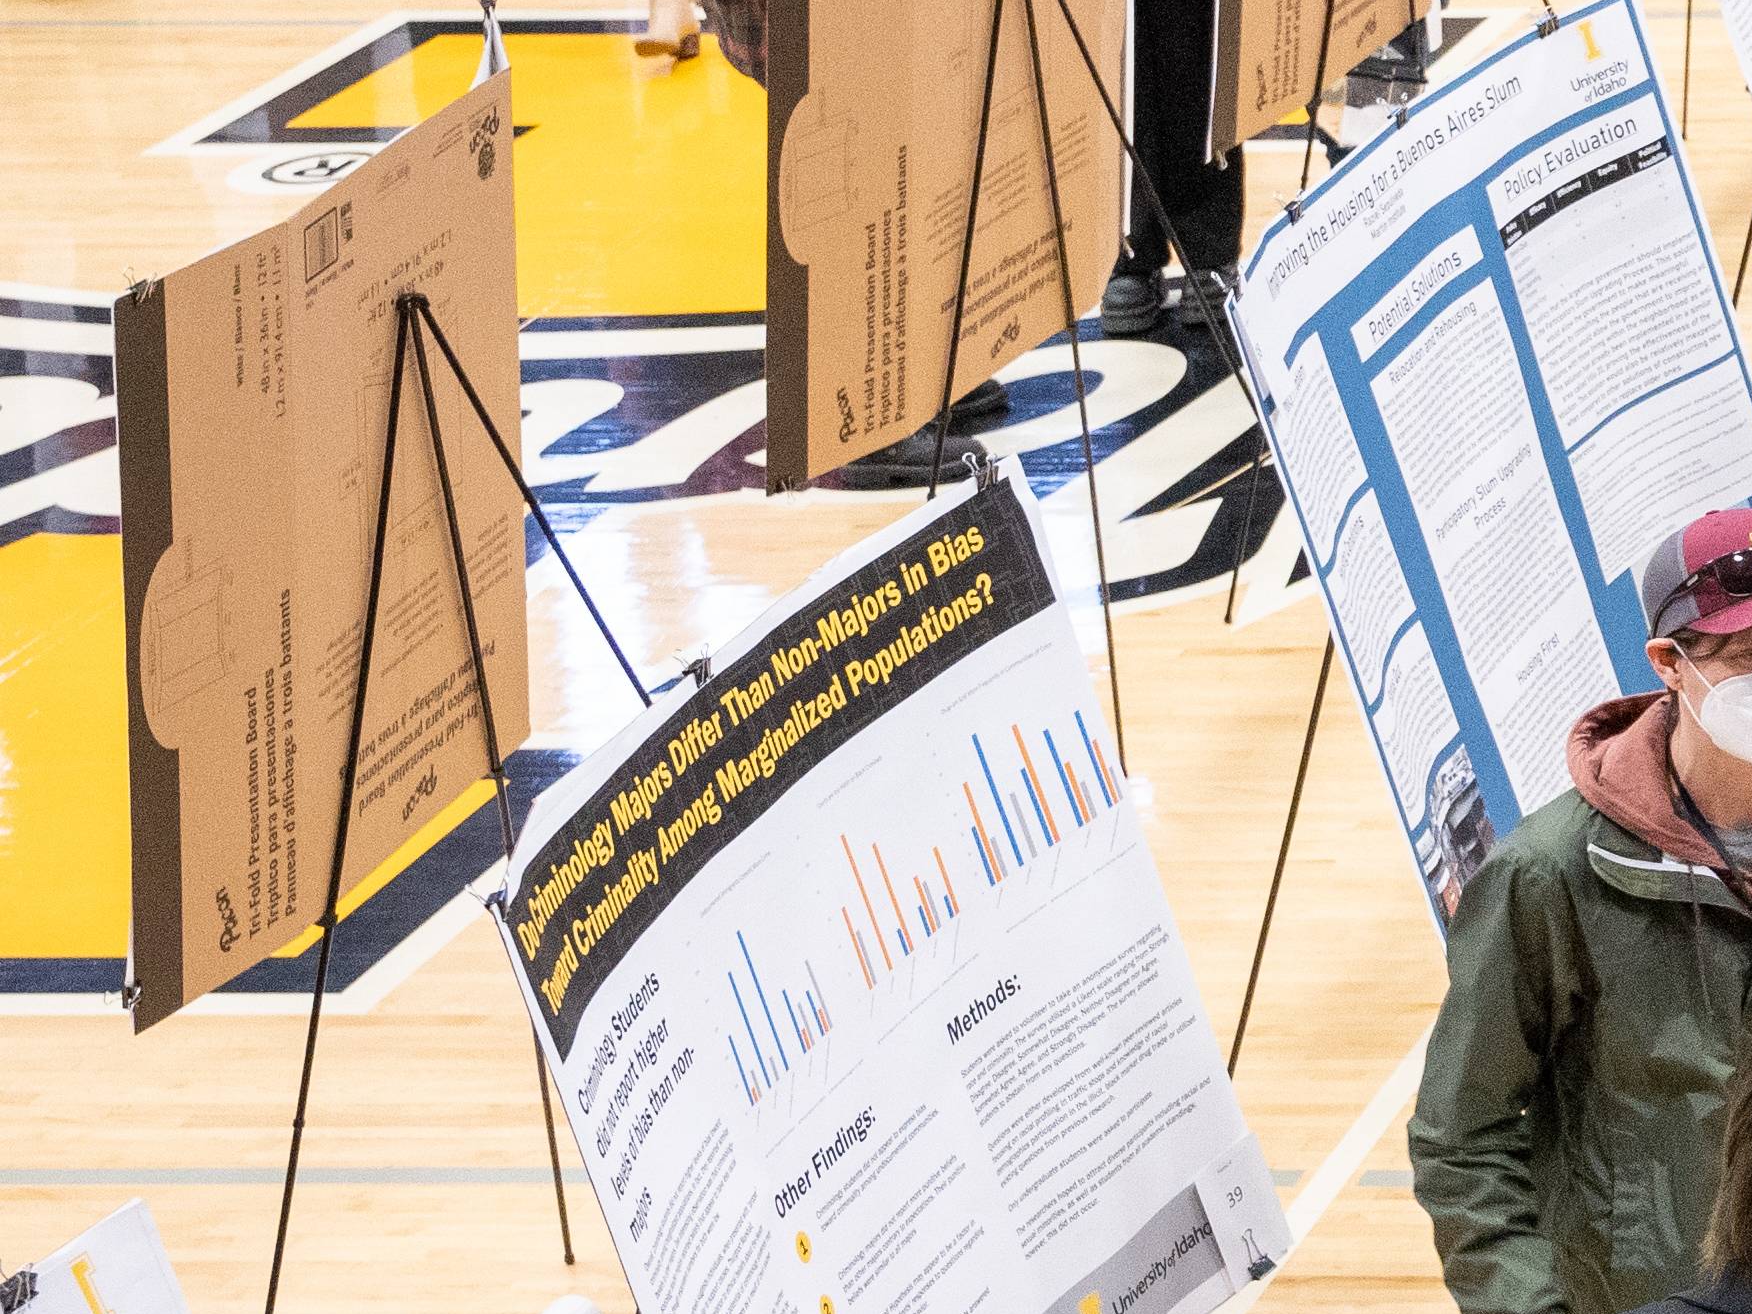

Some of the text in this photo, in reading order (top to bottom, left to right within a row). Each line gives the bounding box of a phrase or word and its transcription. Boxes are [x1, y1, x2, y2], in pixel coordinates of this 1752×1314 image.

[1570, 60, 1628, 92] University
[1585, 77, 1626, 102] of Idaho
[1305, 224, 1329, 252] the
[1326, 185, 1375, 233] Housing
[1370, 169, 1388, 192] for
[1389, 163, 1399, 181] a
[1395, 127, 1445, 174] Buenos
[1446, 100, 1485, 137] Aires
[1484, 75, 1521, 110] Slum
[1503, 117, 1637, 195] Policy Evaluation
[1368, 251, 1462, 343] Potential Solutions
[278, 587, 292, 668] battants
[280, 669, 293, 716] trois
[263, 667, 280, 808] presentaciones
[517, 525, 985, 961] Do Criminology Majors Differ Than Non-Majors in Bias
[243, 686, 261, 940] Tri-Fold Presentation Board
[281, 733, 299, 833] d'affichage
[539, 571, 994, 1016] Toward Criminality Among Marginalized Populations?
[267, 811, 282, 854] para
[284, 837, 297, 917] Panneau
[215, 885, 241, 953] Pacon
[578, 972, 660, 1115] Criminology Students
[945, 973, 1021, 1045] Methods:
[596, 1017, 669, 1159] did not report higher
[610, 1046, 695, 1201] levels of bias than non-
[773, 1104, 876, 1219] Other Findings:
[1226, 1186, 1243, 1208] 39
[629, 1186, 653, 1243] majors
[799, 1240, 808, 1256] 1
[1167, 1250, 1176, 1268] of
